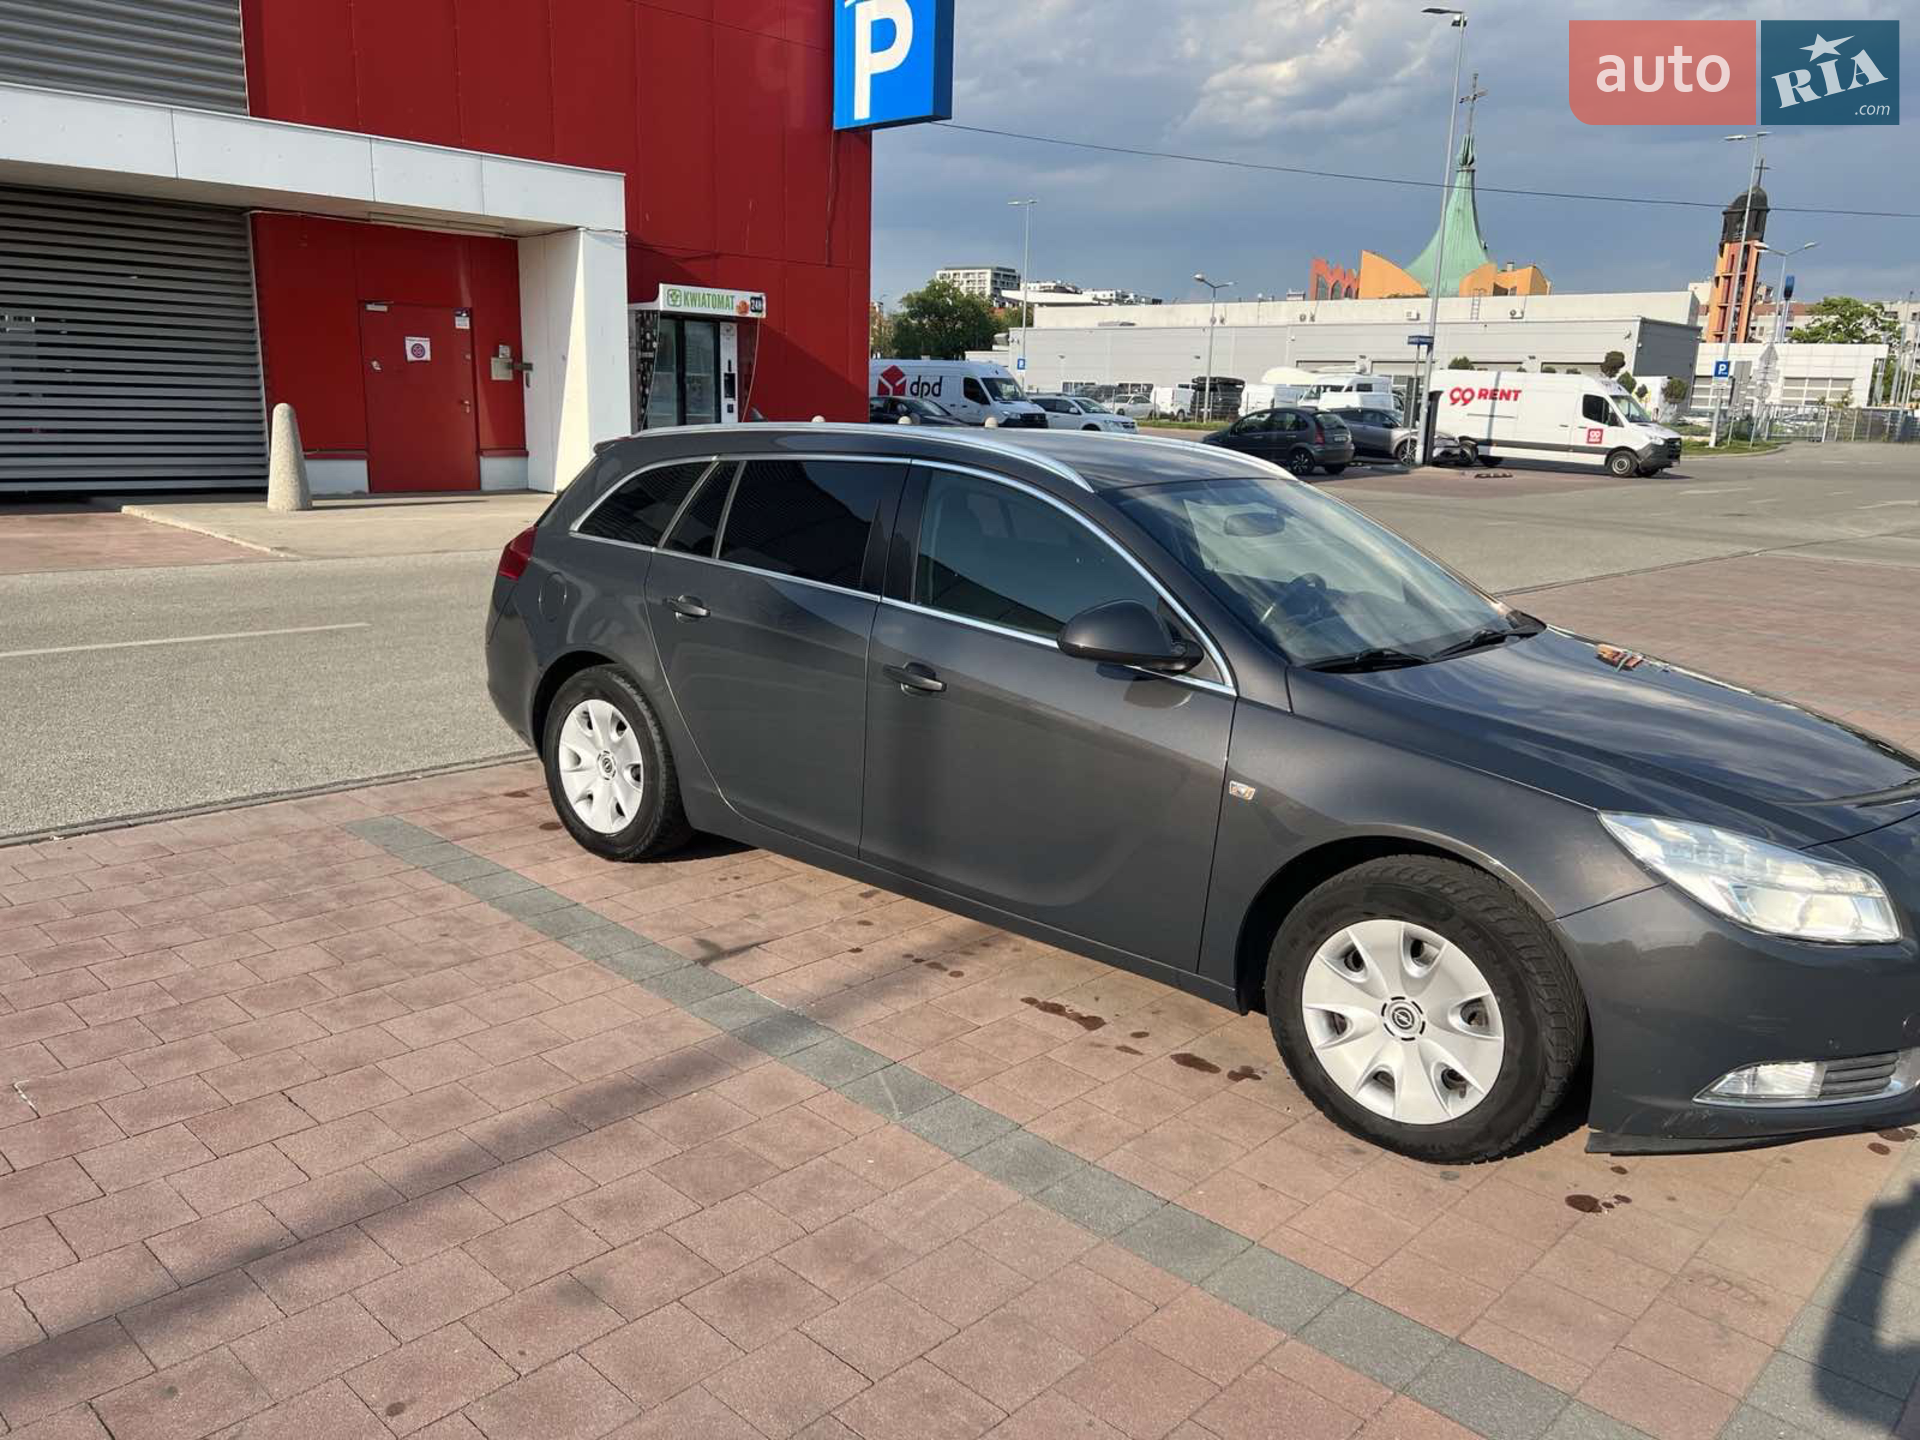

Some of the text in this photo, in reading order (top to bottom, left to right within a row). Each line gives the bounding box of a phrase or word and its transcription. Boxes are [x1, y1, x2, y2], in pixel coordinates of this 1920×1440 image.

[854, 0, 913, 120] P
[683, 290, 735, 311] KWIATOMAT
[1718, 363, 1727, 375] P
[910, 375, 943, 398] dpd
[1449, 386, 1522, 406] 99 RENT
